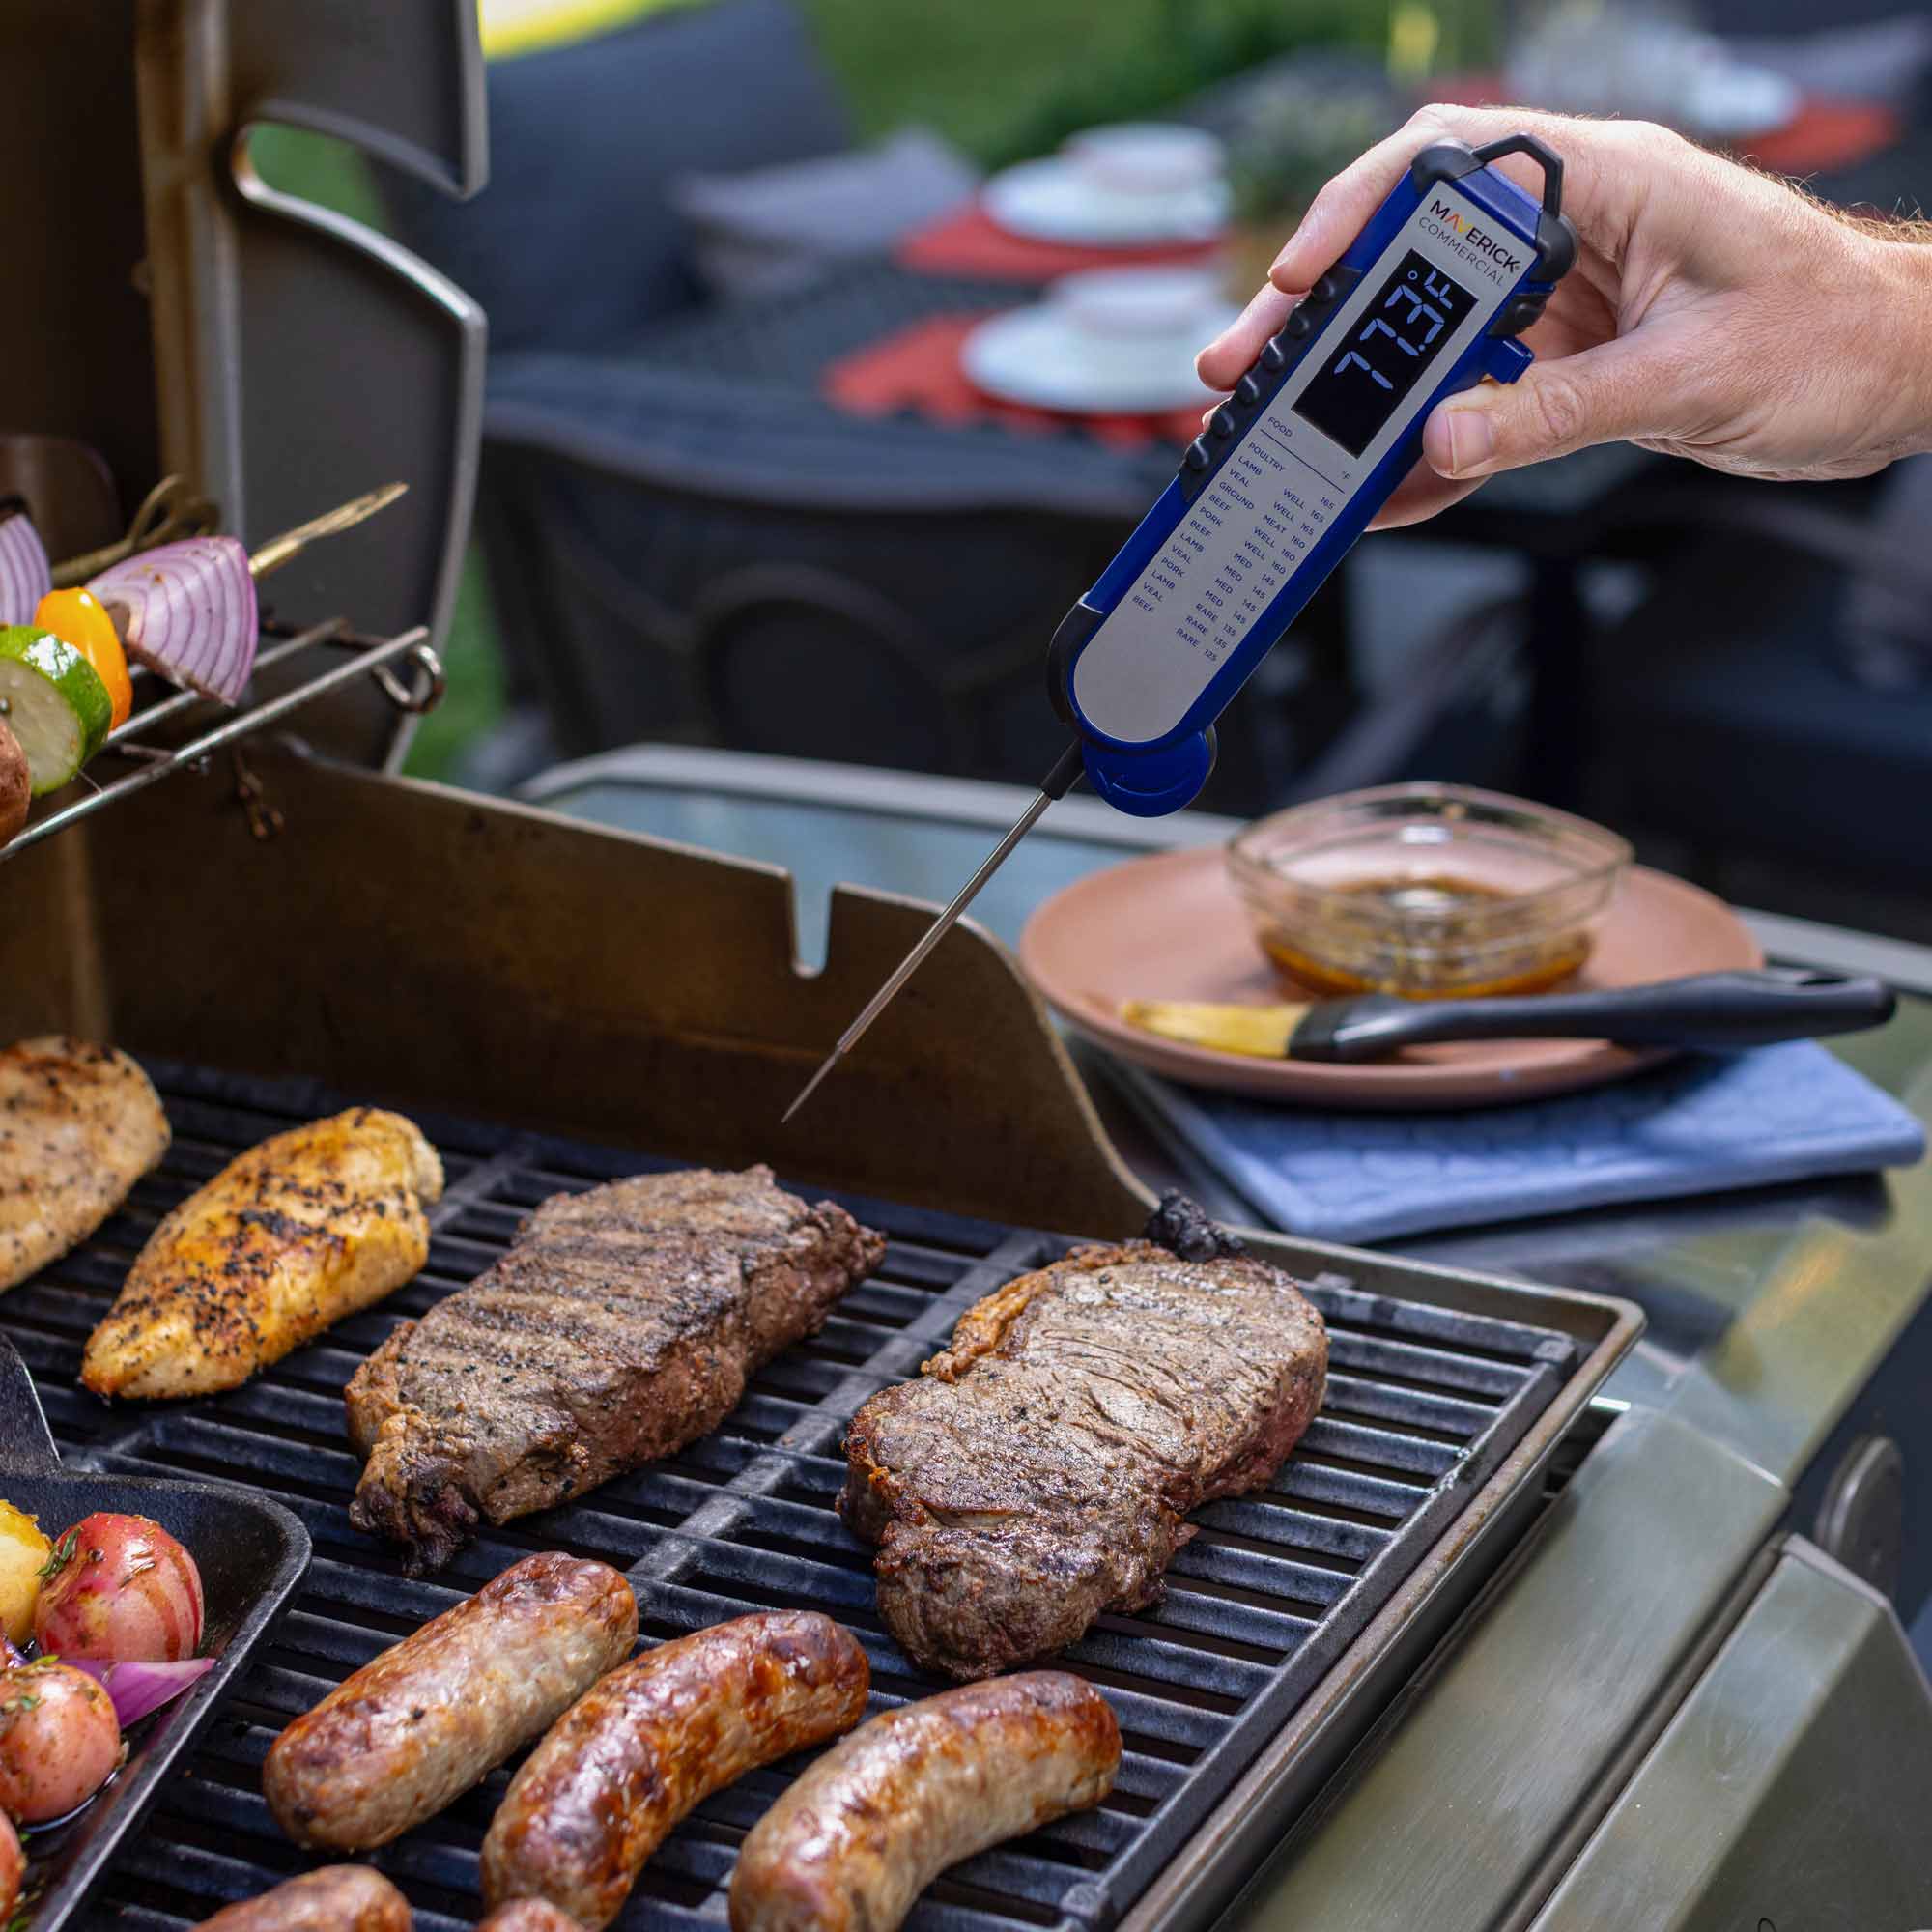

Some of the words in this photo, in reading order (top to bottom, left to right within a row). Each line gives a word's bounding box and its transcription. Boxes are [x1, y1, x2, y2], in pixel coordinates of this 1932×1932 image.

[1418, 217, 1506, 286] COMMERCIAL
[1430, 199, 1519, 274] MAVERICK
[1268, 417, 1293, 437] FOOD
[1219, 482, 1254, 510] GROUND
[1263, 514, 1287, 534] MEAT
[1229, 469, 1250, 487] VEAL
[1274, 502, 1295, 522] WELL
[1300, 523, 1314, 535] 165
[1238, 455, 1262, 476] LAMB
[1283, 488, 1306, 510] WELL
[1310, 510, 1324, 523] 165
[1248, 442, 1285, 472] POULTRY
[1321, 497, 1335, 510] 165
[1190, 519, 1212, 539] BEEF
[1234, 553, 1252, 569] MED
[1261, 573, 1276, 587] 145
[1199, 506, 1223, 526] PORK
[1244, 540, 1266, 561] WELL
[1272, 561, 1286, 575] 160
[1208, 494, 1231, 512] BEEF
[1253, 526, 1276, 548] WELL
[1281, 548, 1296, 562] 160
[1161, 557, 1185, 578] PORK
[1205, 590, 1223, 607] MED
[1233, 611, 1247, 624] 145
[1171, 544, 1191, 565] VEAL
[1214, 578, 1234, 595] MED
[1242, 598, 1256, 612] 145
[1180, 533, 1204, 553] LAMB
[1224, 565, 1243, 582] MED
[1252, 586, 1266, 599] 145
[1132, 595, 1155, 612] BEEF
[1175, 628, 1200, 648] RARE
[1143, 581, 1165, 602] VEAL
[1185, 615, 1208, 636] RARE
[1151, 569, 1176, 590] LAMB
[1195, 603, 1219, 622] RARE
[1222, 624, 1237, 637] 135
